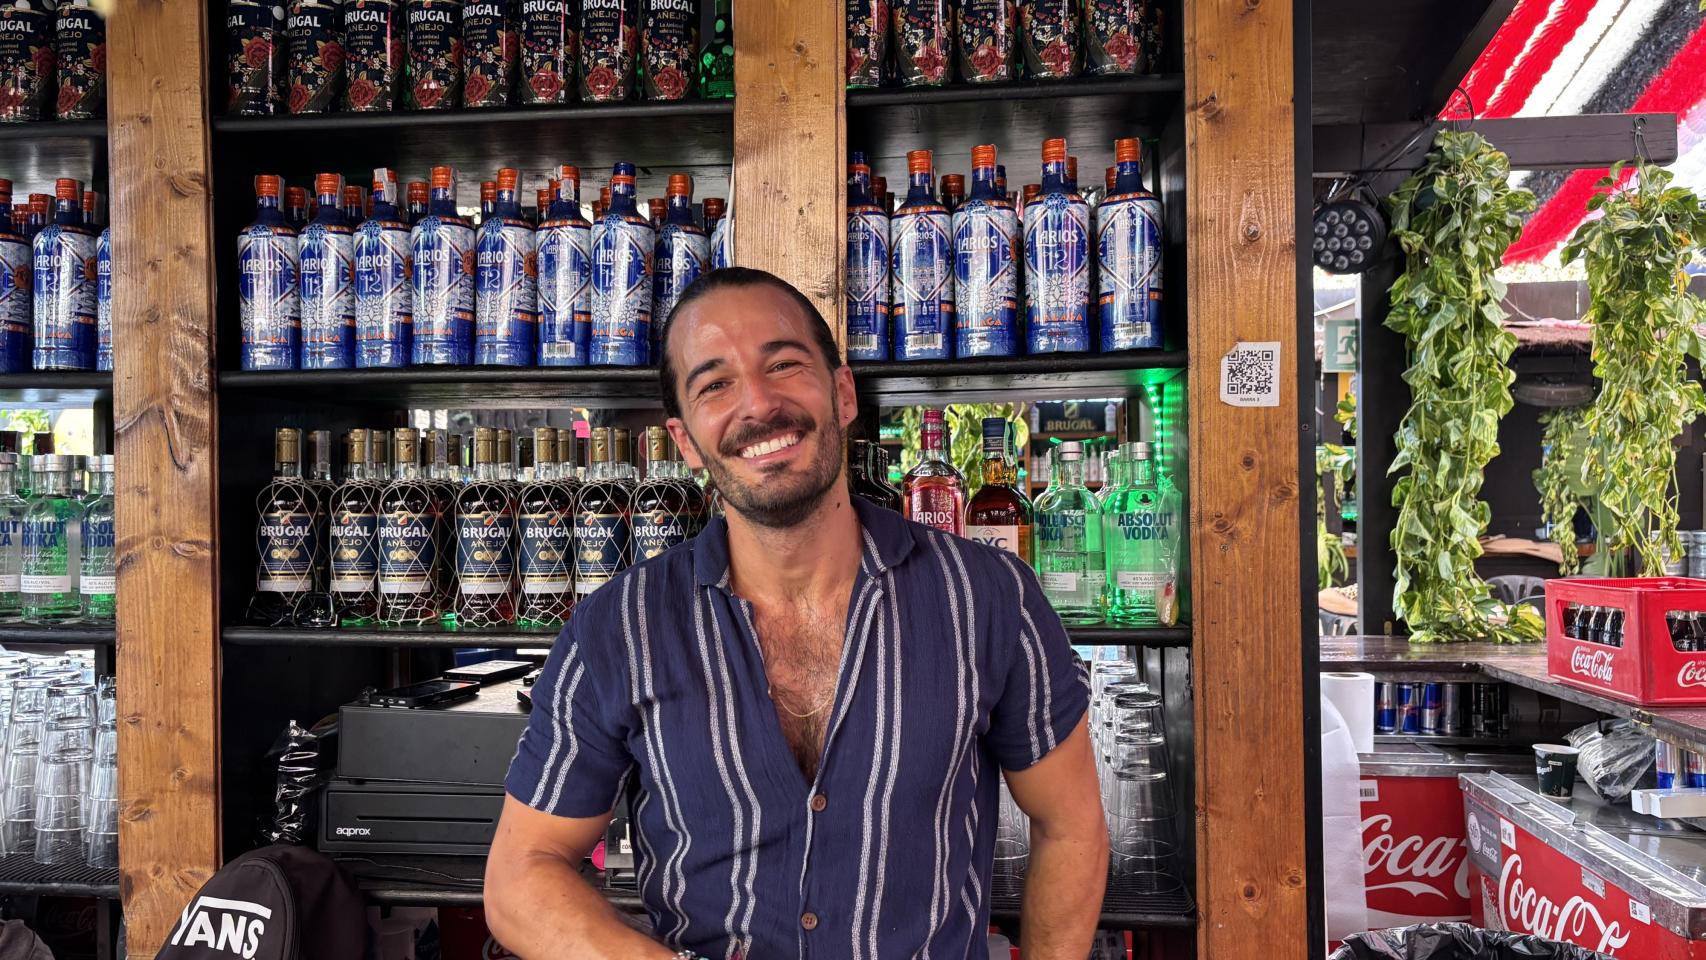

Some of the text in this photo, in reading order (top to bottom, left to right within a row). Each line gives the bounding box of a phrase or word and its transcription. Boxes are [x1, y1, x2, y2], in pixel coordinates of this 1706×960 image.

[462, 4, 501, 20] BRUGAL
[523, 0, 571, 16] BRUGAL
[650, 0, 695, 14] BRUGAL
[345, 10, 388, 24] BRUGAL
[410, 10, 453, 24] BRUGAL
[529, 13, 563, 23] AÑEJO
[588, 10, 619, 19] AÑEJO
[656, 11, 688, 21] AÑEJO
[414, 23, 445, 32] AÑEJO
[958, 236, 998, 254] LARIOS
[356, 254, 391, 272] LARIOS
[414, 249, 449, 266] LARIOS
[477, 251, 512, 268] LARIOS
[242, 259, 283, 274] LARIOS
[360, 273, 383, 293] 12
[418, 268, 439, 288] 12
[481, 269, 501, 289] 12
[1118, 512, 1172, 527] ABSOLUT
[260, 525, 311, 537] BRUGAL
[380, 526, 429, 538] BRUGAL
[462, 527, 511, 538] BRUGAL
[634, 525, 682, 537] BRUGAL
[1123, 526, 1169, 540] VODKA
[386, 538, 421, 547] AÑEJO
[470, 539, 505, 548] AÑEJO
[1571, 645, 1615, 682] Coca-Cola
[335, 827, 371, 837] aqprox
[170, 895, 272, 960] VANS
